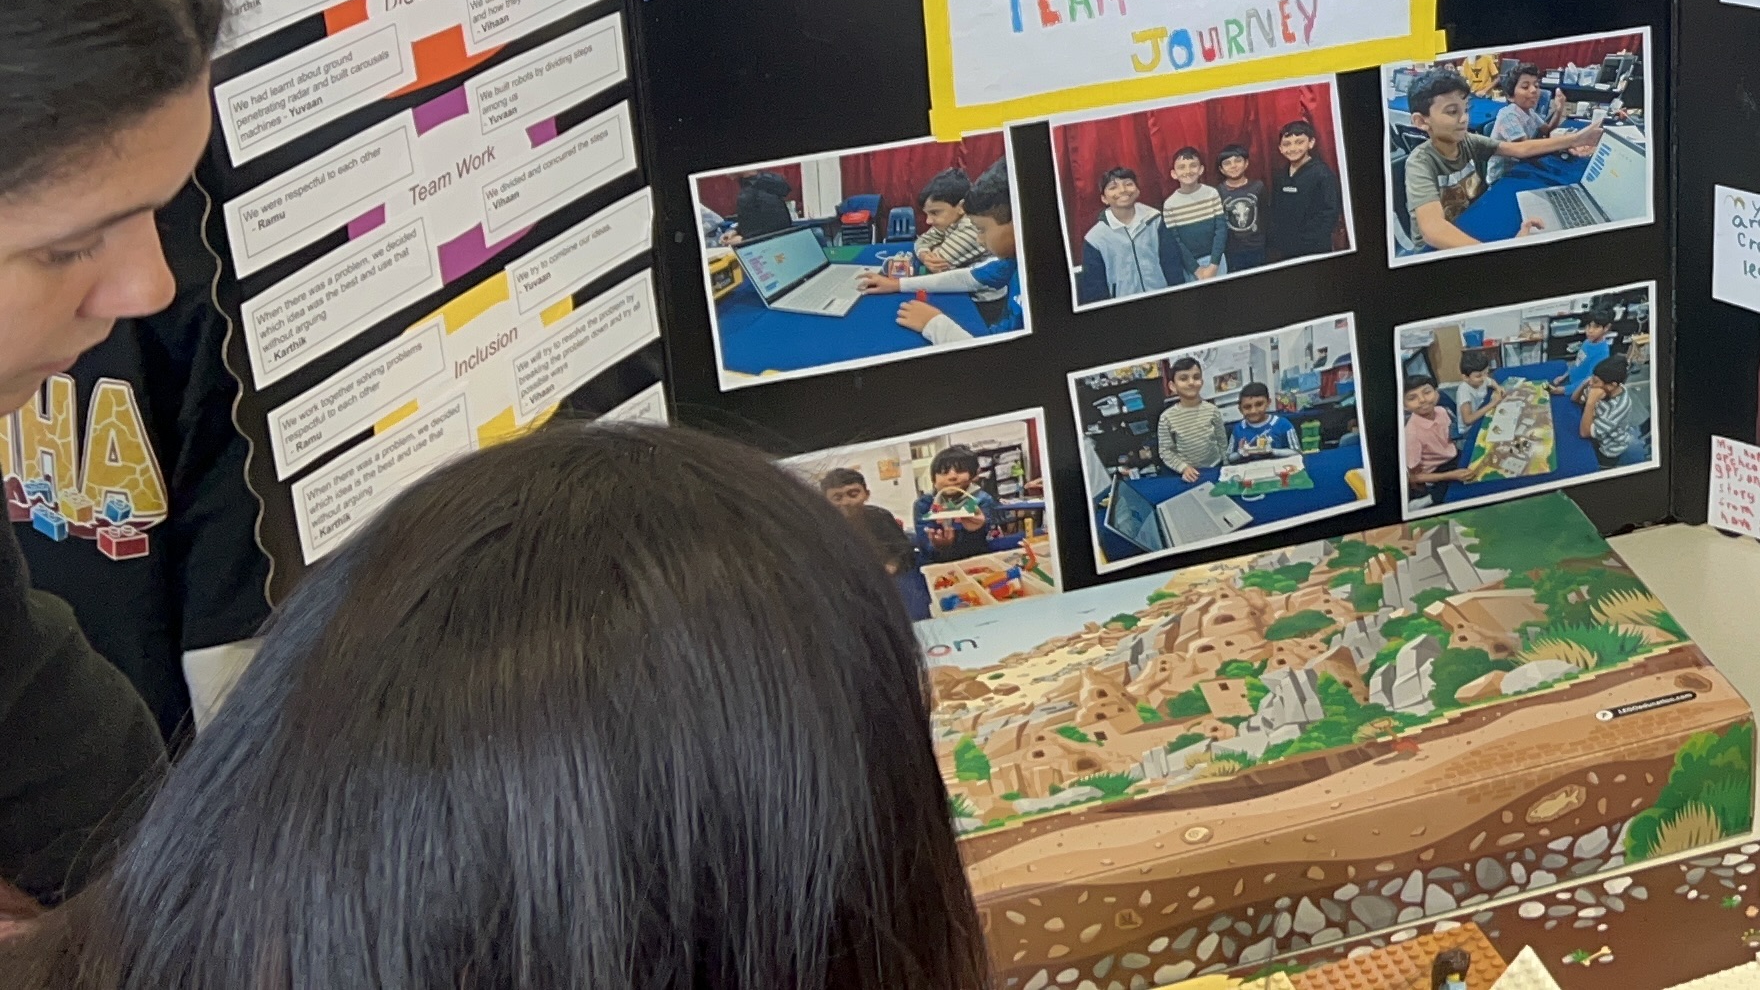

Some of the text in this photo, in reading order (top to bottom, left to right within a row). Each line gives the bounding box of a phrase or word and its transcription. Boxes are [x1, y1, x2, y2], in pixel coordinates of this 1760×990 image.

[409, 145, 497, 207] Team Work
[453, 325, 520, 379] Inclusion
[0, 372, 168, 518] HA
